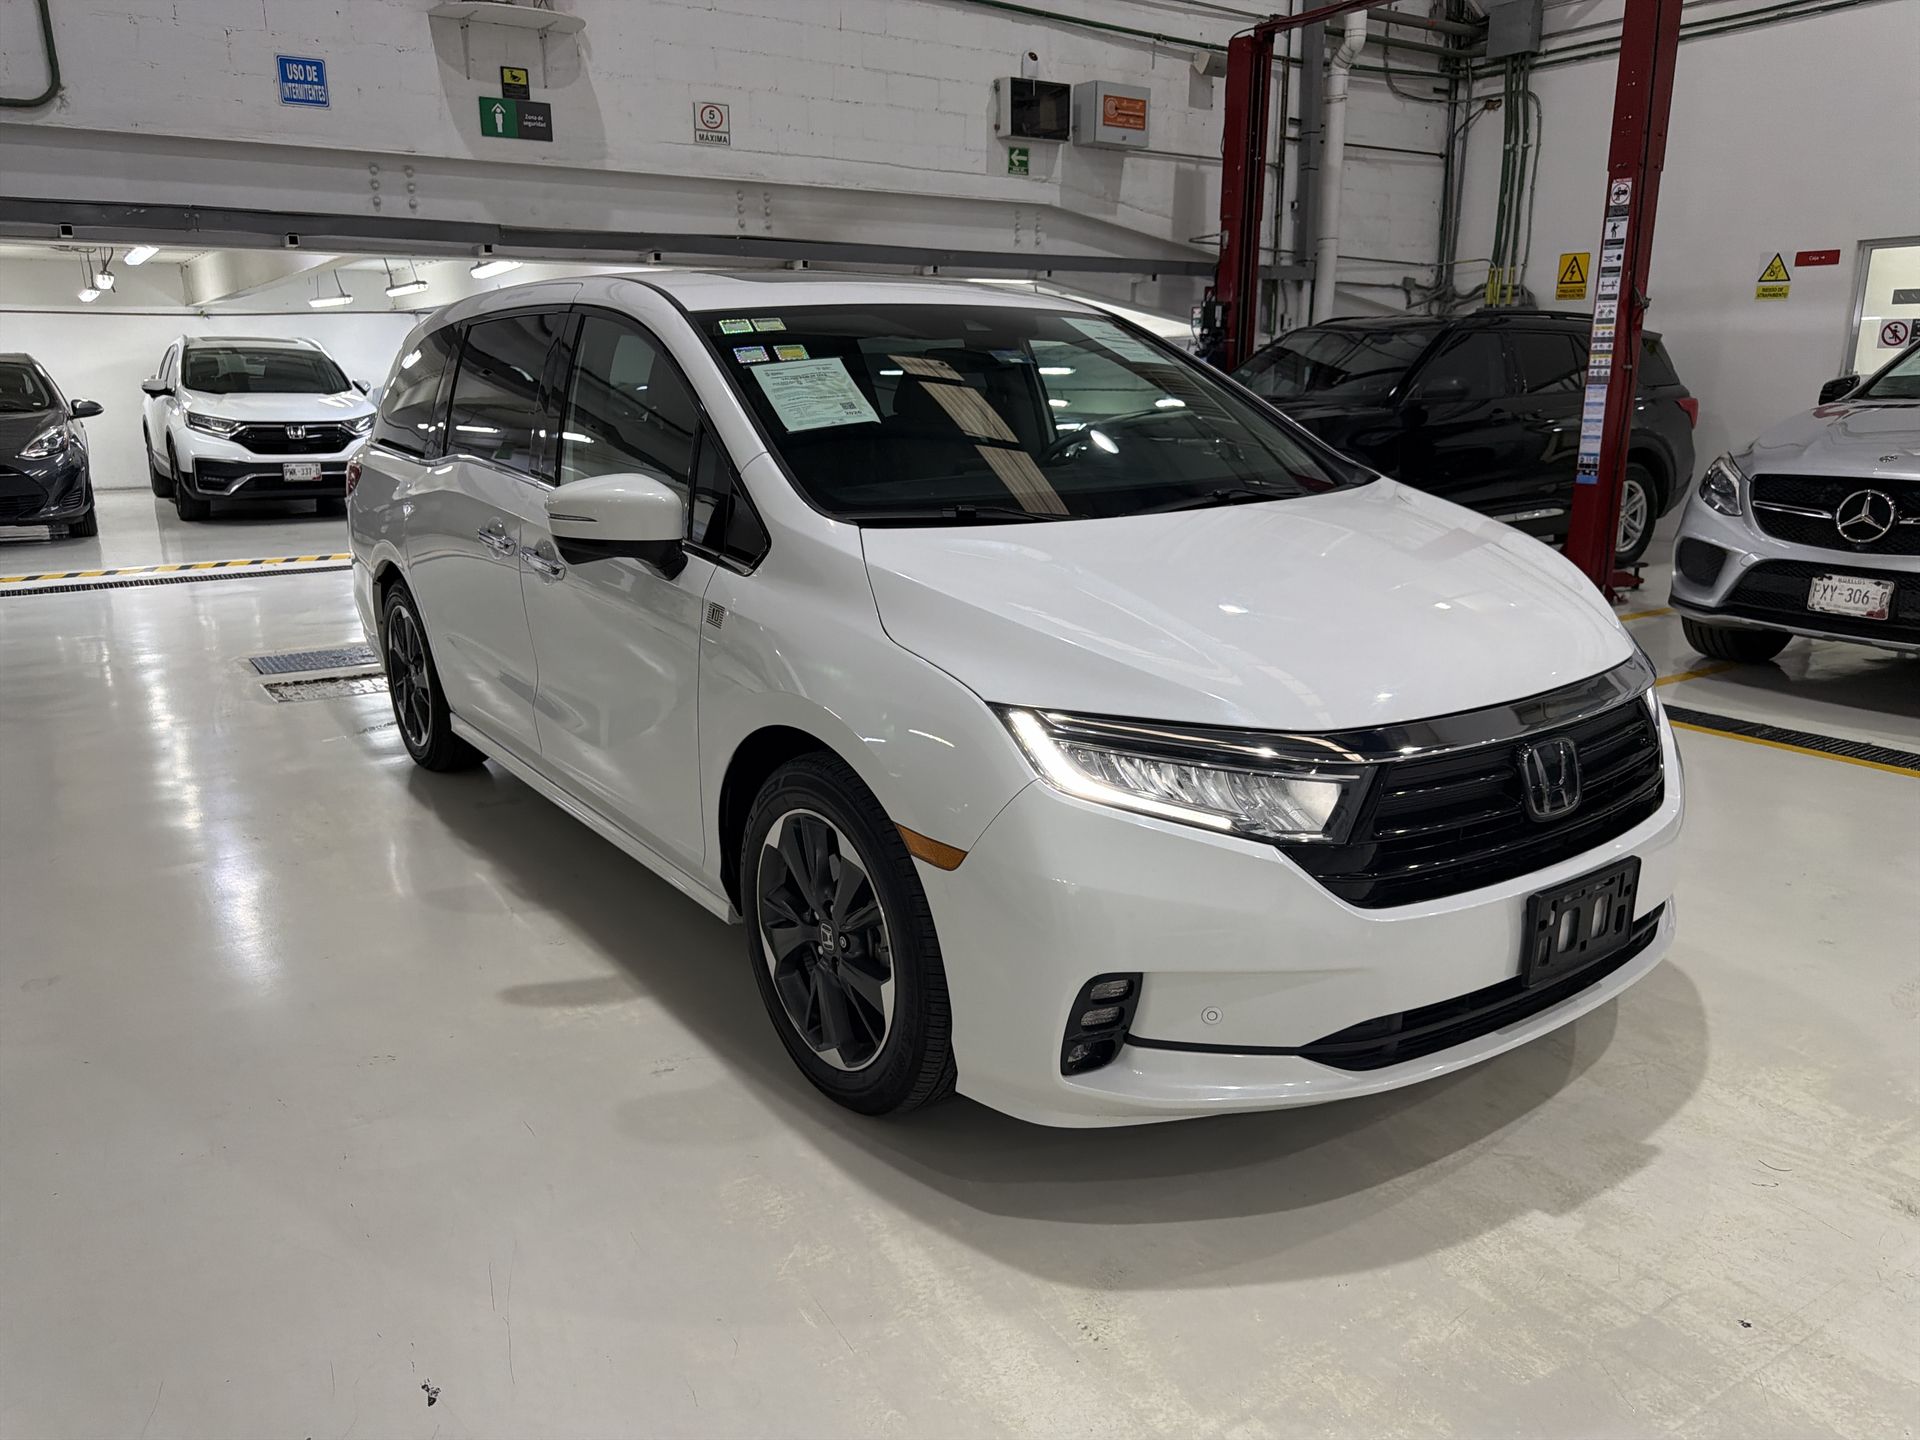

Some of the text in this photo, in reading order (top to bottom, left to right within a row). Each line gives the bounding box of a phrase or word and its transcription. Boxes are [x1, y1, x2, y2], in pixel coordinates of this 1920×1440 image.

[286, 63, 318, 82] USO DE
[282, 82, 326, 102] INTERMITENTES
[524, 113, 537, 121] Zona
[708, 109, 716, 120] 5
[523, 120, 547, 128] seguridad
[698, 132, 728, 144] MÁXIMA
